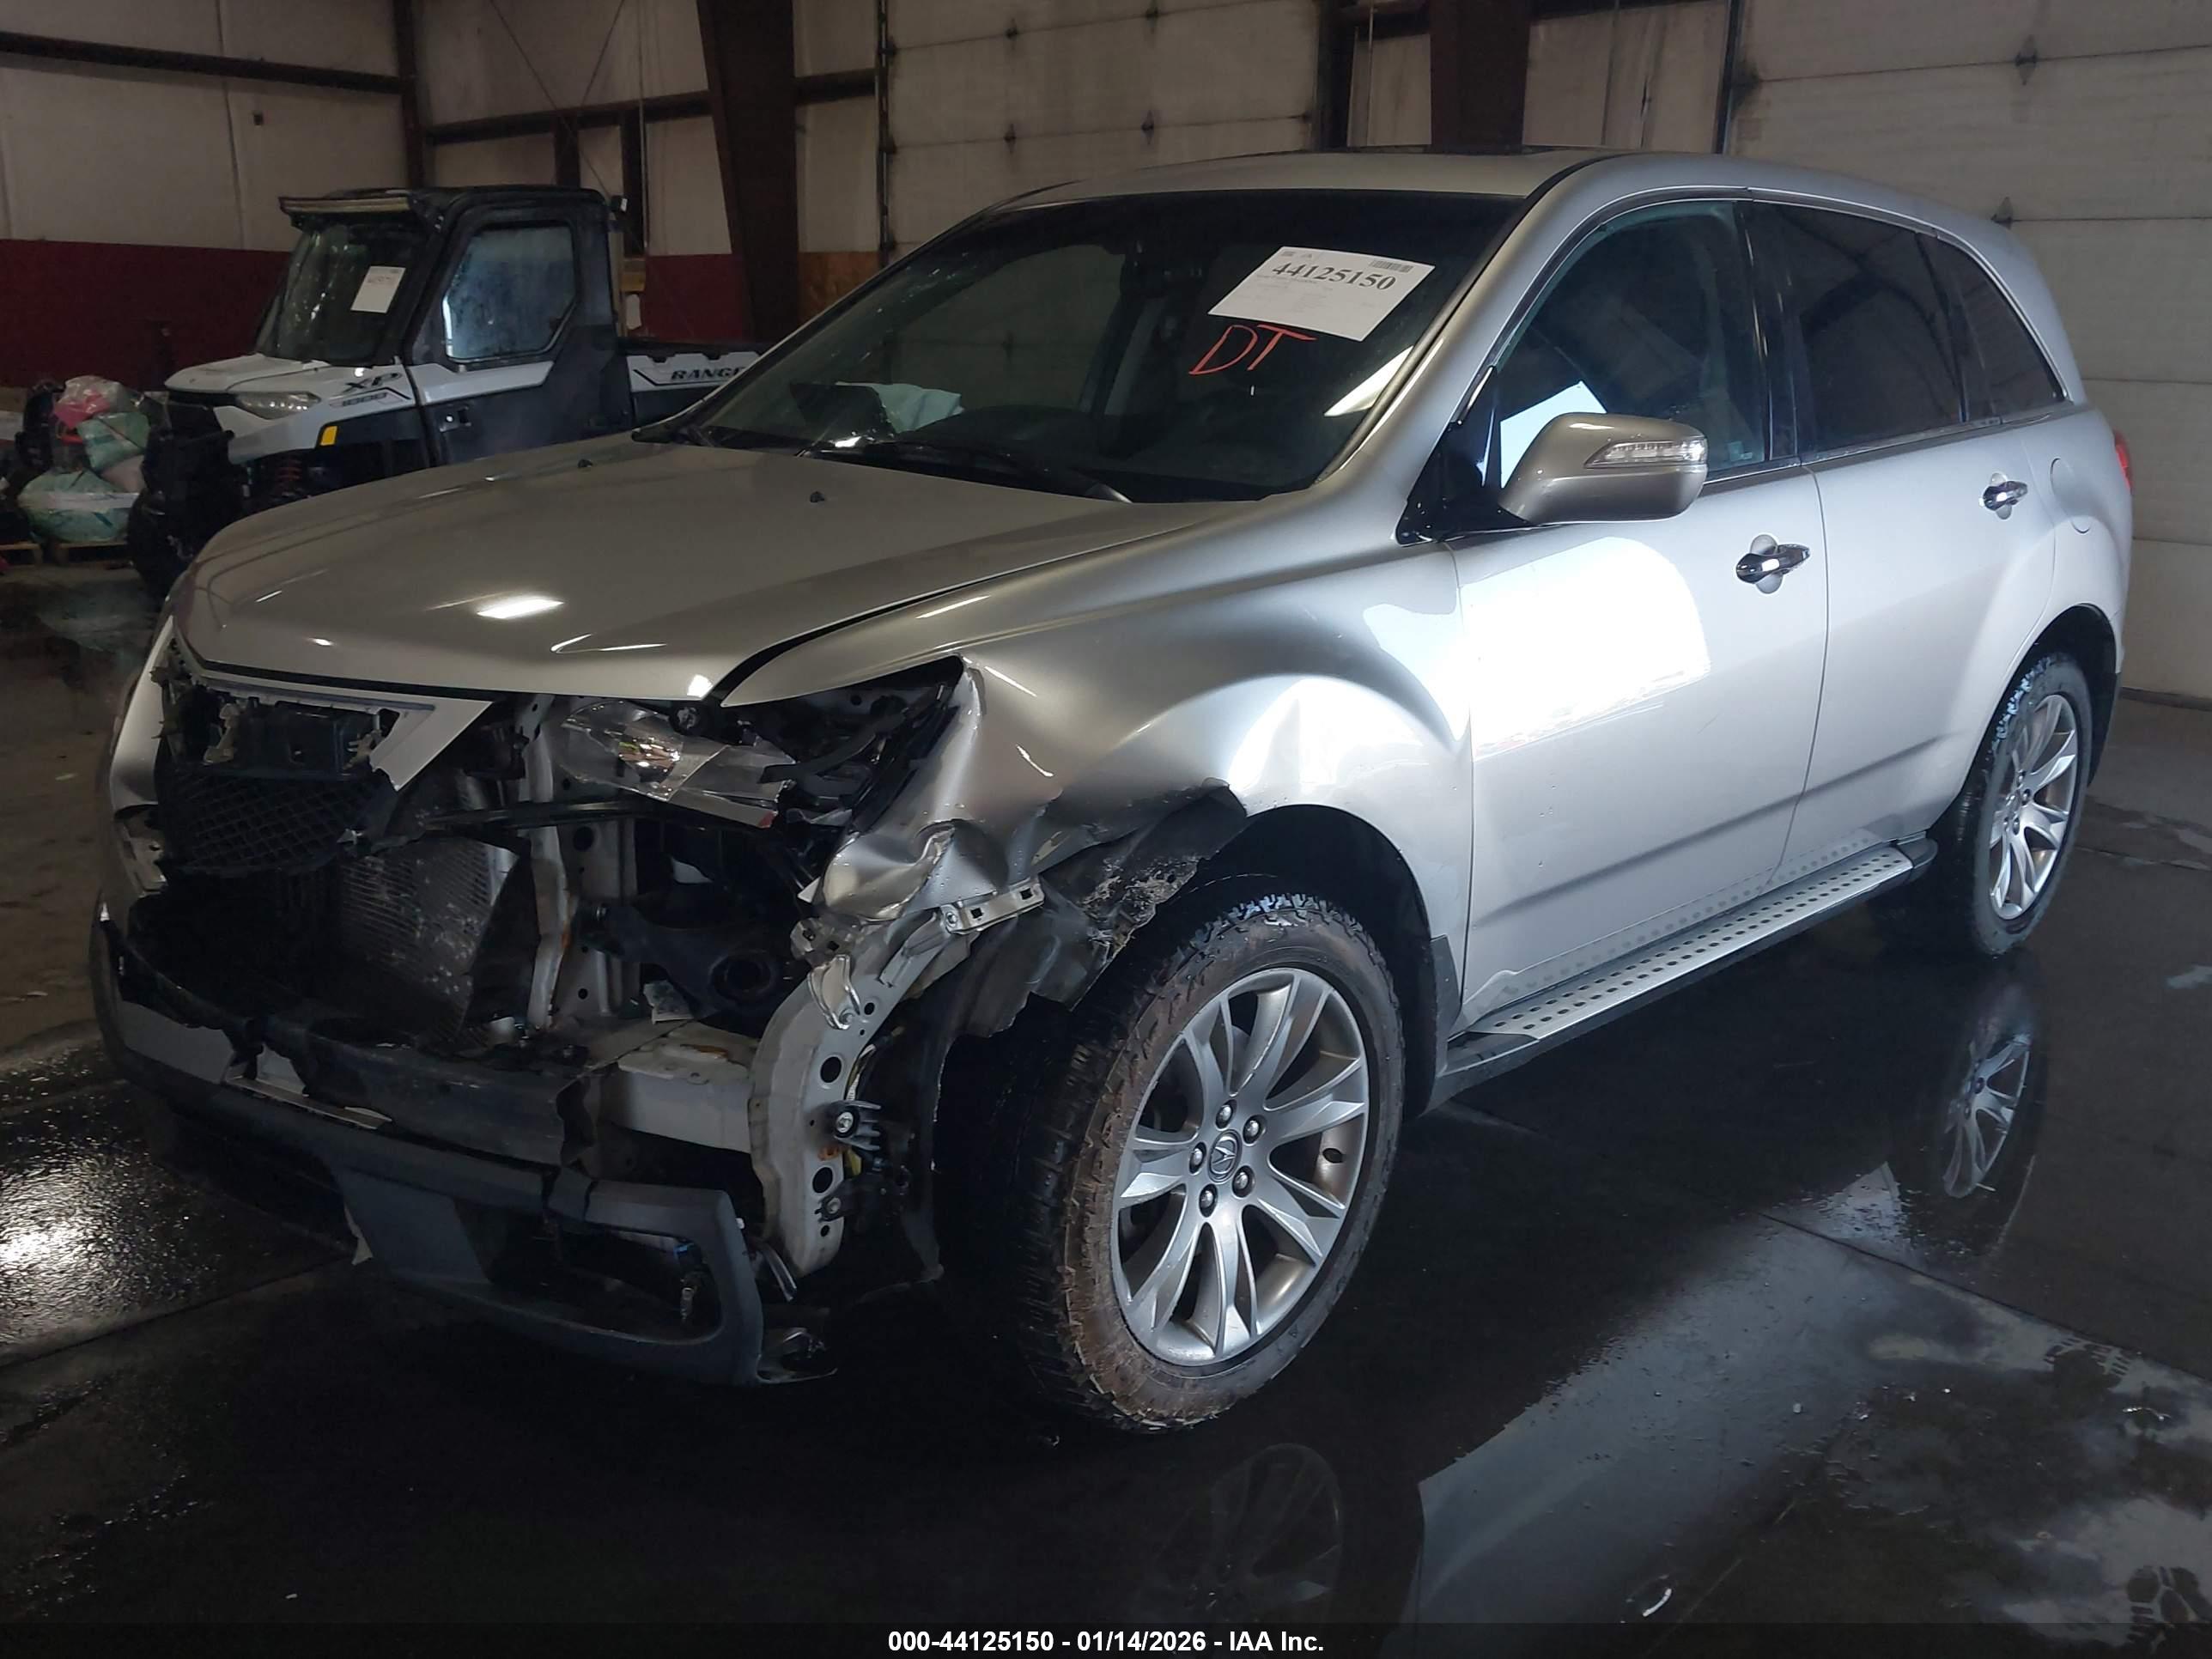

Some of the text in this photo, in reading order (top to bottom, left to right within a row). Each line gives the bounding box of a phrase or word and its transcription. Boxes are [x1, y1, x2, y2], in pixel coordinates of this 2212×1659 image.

[1272, 262, 1397, 290] 44125150
[1188, 324, 1319, 375] DT
[342, 373, 402, 393] XP
[671, 366, 747, 380] RANG
